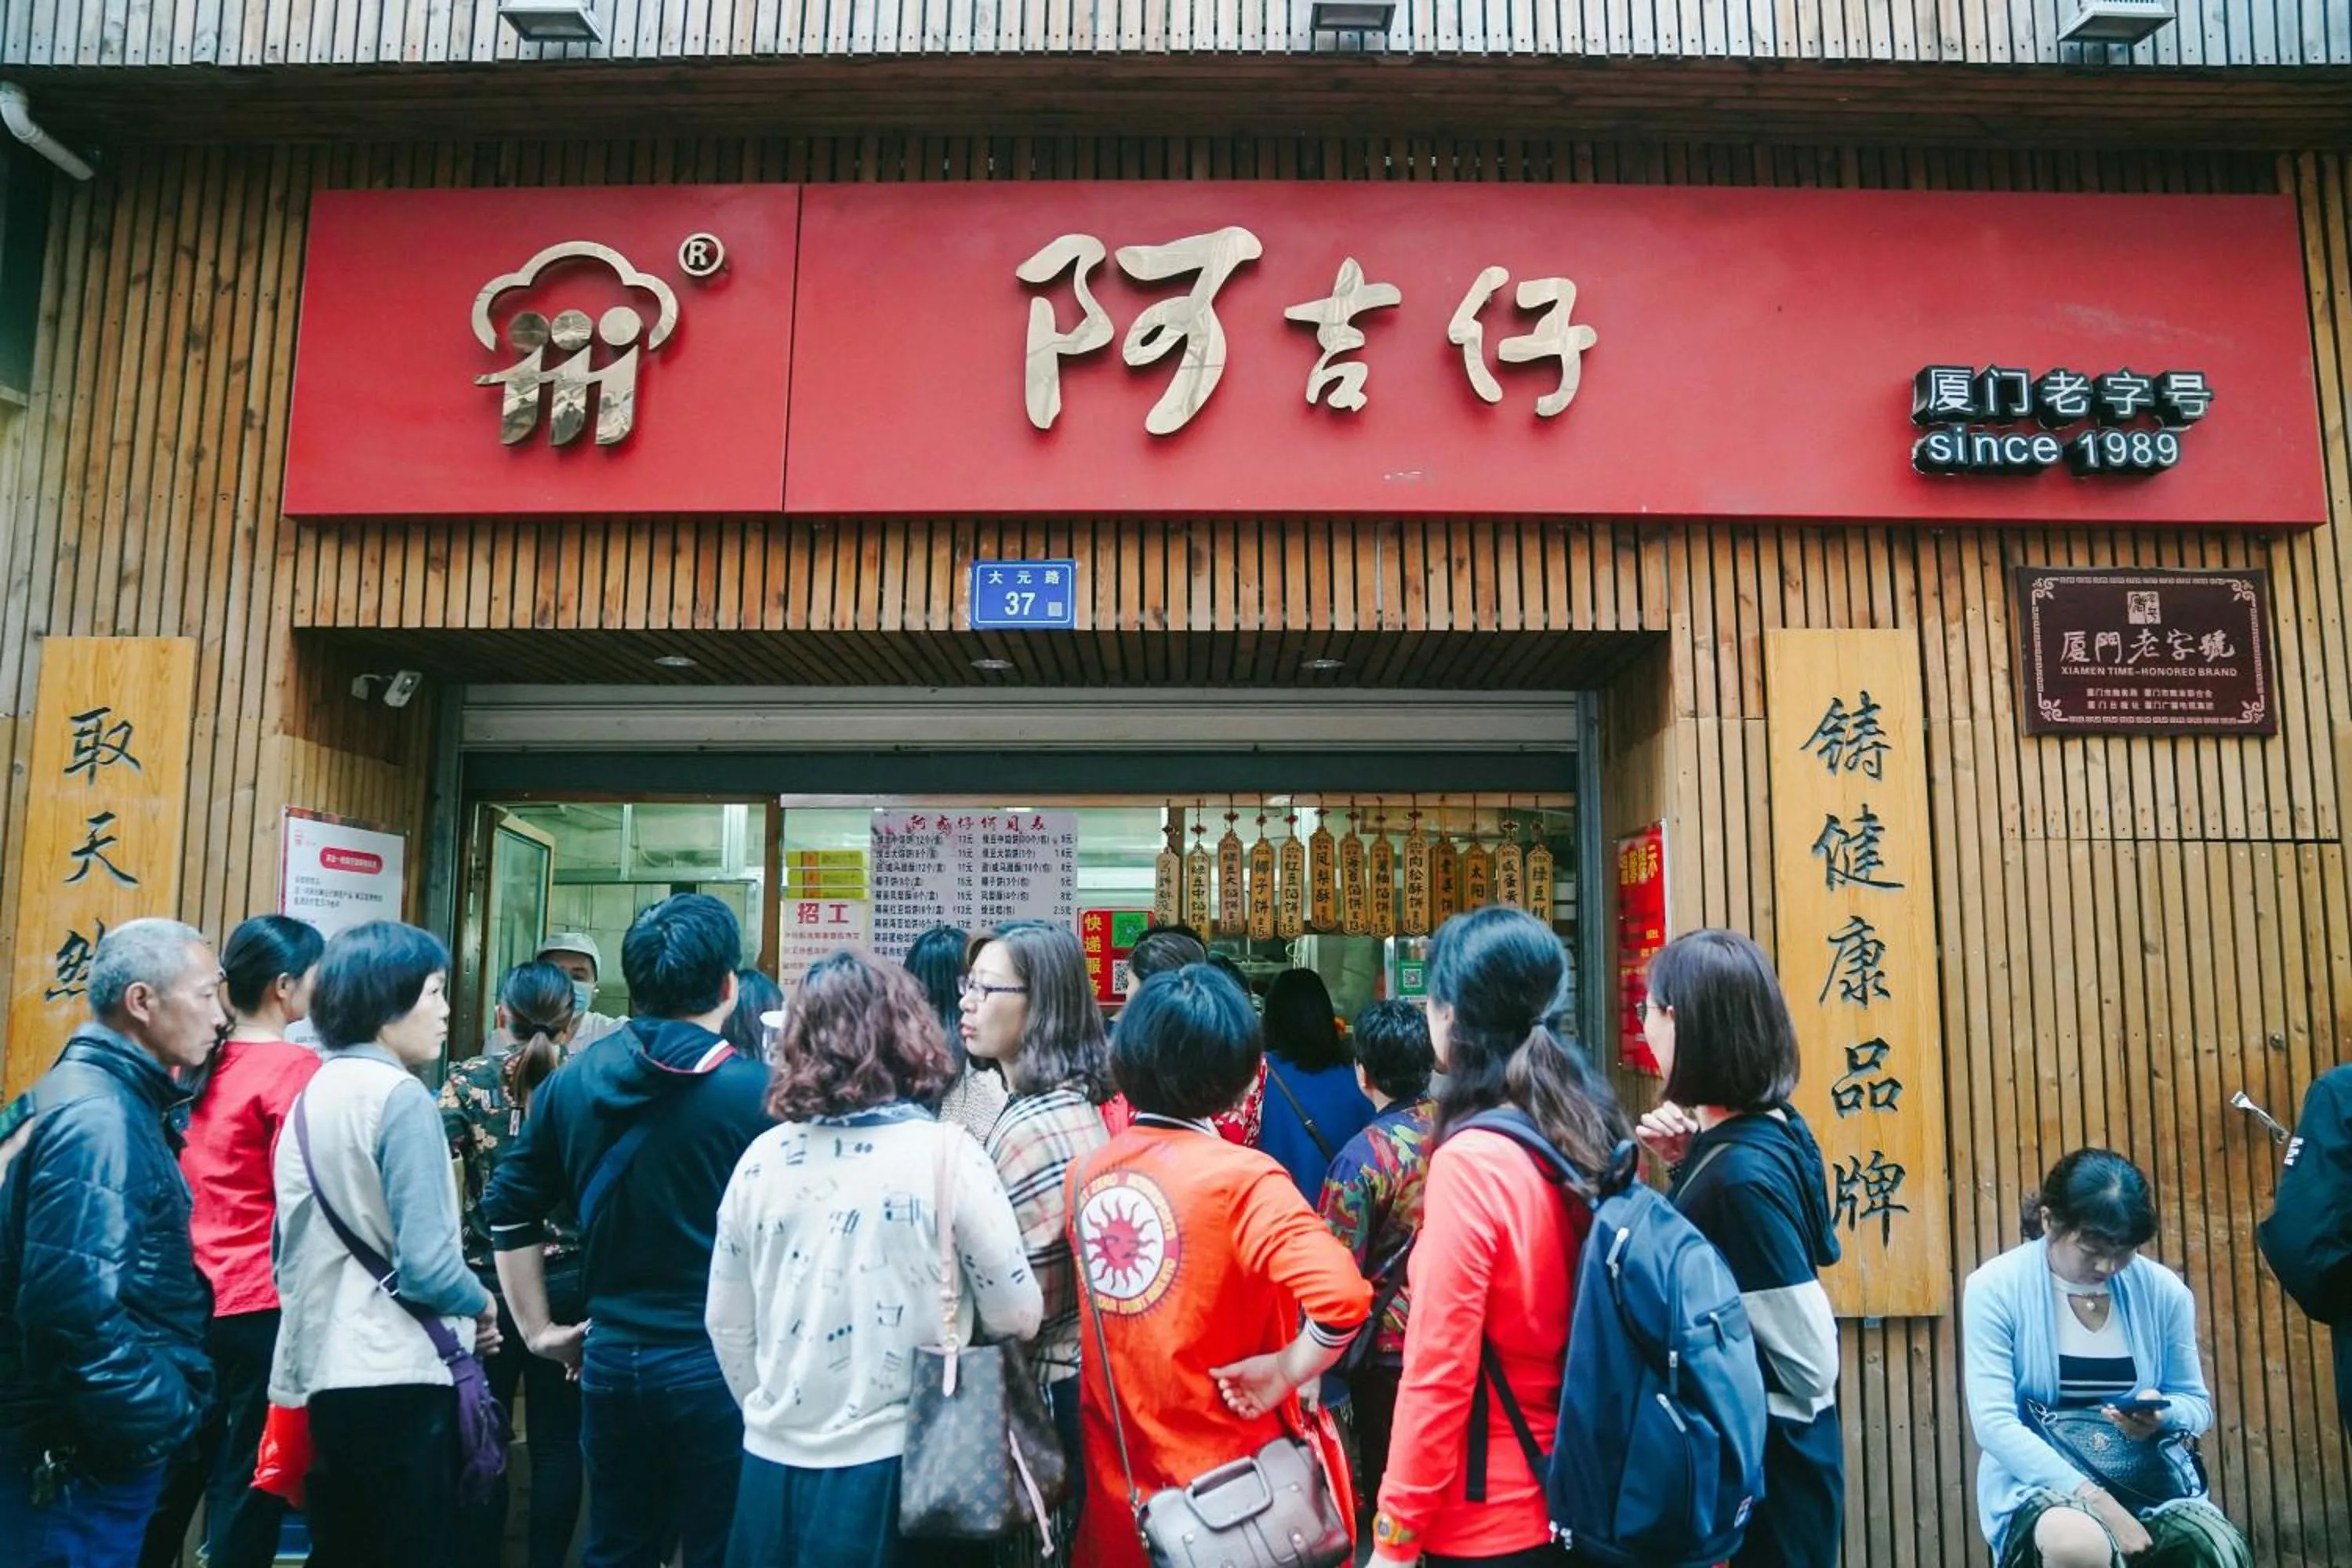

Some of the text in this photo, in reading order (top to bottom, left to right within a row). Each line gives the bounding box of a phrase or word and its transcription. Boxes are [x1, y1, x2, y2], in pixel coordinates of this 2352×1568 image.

[1015, 226, 1597, 434] 阿吉仔
[1928, 368, 2213, 416] 厦门老字号
[1929, 426, 2178, 466] since 1989
[988, 570, 1060, 585] 大元路
[1004, 591, 1036, 615] 37
[2060, 628, 2236, 664] 厦門老字號
[2061, 667, 2238, 677] XIAMEN TIME-HONORED BRAND
[1254, 859, 1269, 916] 椰子饼
[1285, 861, 1299, 914] 红豆馅饼
[1316, 851, 1331, 904] 凤梨酥
[797, 902, 849, 924] 招工
[1801, 690, 1911, 1249] 铸健康品牌
